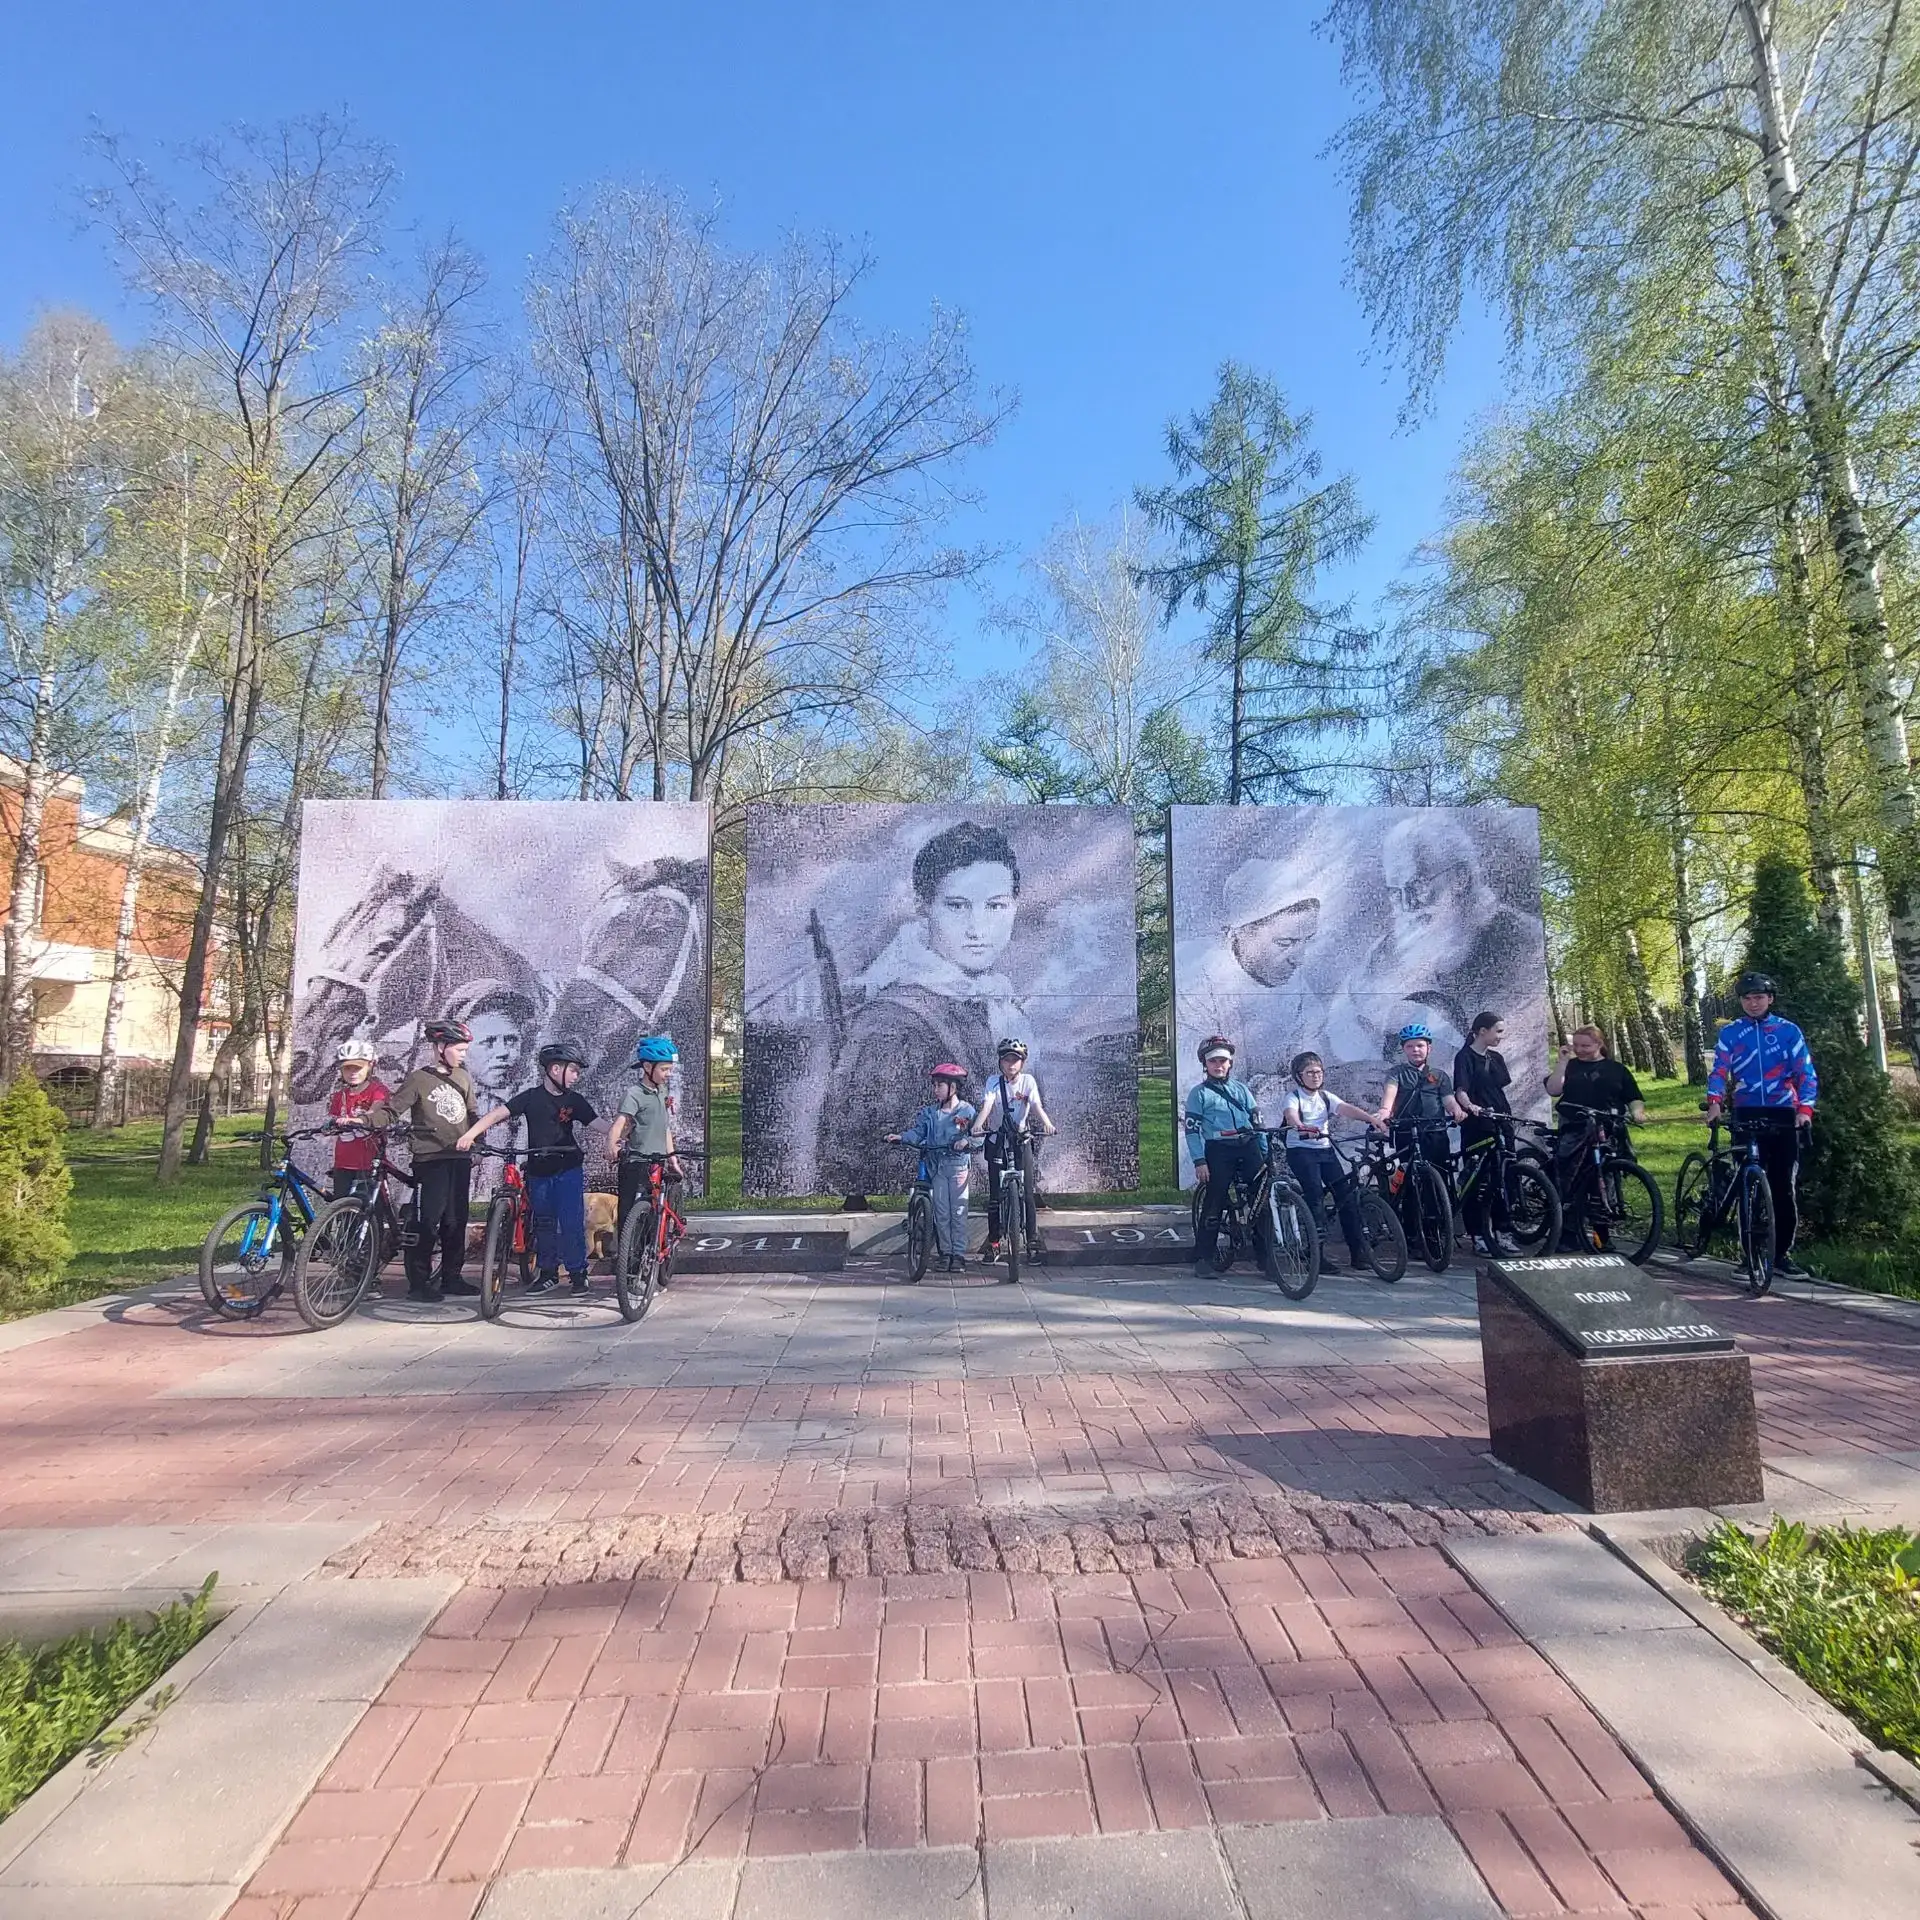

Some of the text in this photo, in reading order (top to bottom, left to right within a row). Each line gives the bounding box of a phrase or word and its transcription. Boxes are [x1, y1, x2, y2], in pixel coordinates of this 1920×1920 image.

[1074, 1227, 1189, 1244] 194
[677, 1236, 808, 1252] 941
[1497, 1256, 1625, 1272] БЕССМЕРТНОМУ
[1574, 1290, 1631, 1304] ПОЛКУ
[1580, 1324, 1719, 1344] ПОСВЯЩАЕТСЯ
